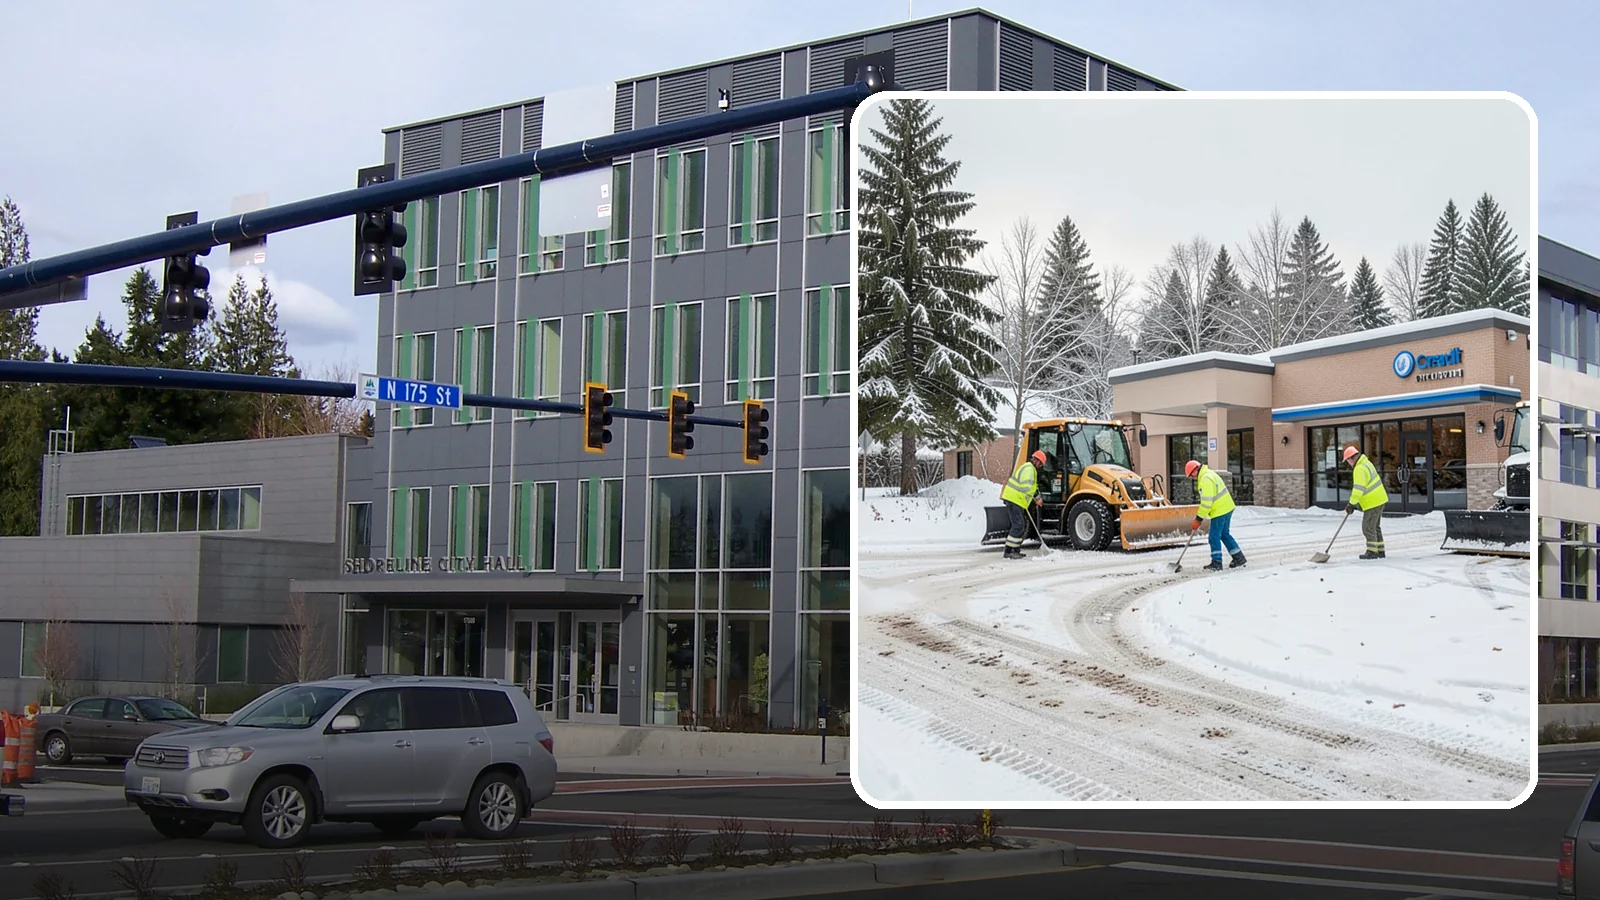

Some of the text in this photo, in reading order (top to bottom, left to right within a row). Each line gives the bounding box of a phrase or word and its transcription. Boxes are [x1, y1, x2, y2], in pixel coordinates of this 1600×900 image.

[387, 380, 451, 406] N 175 St
[344, 555, 526, 574] SHORELINE CITY HALL
